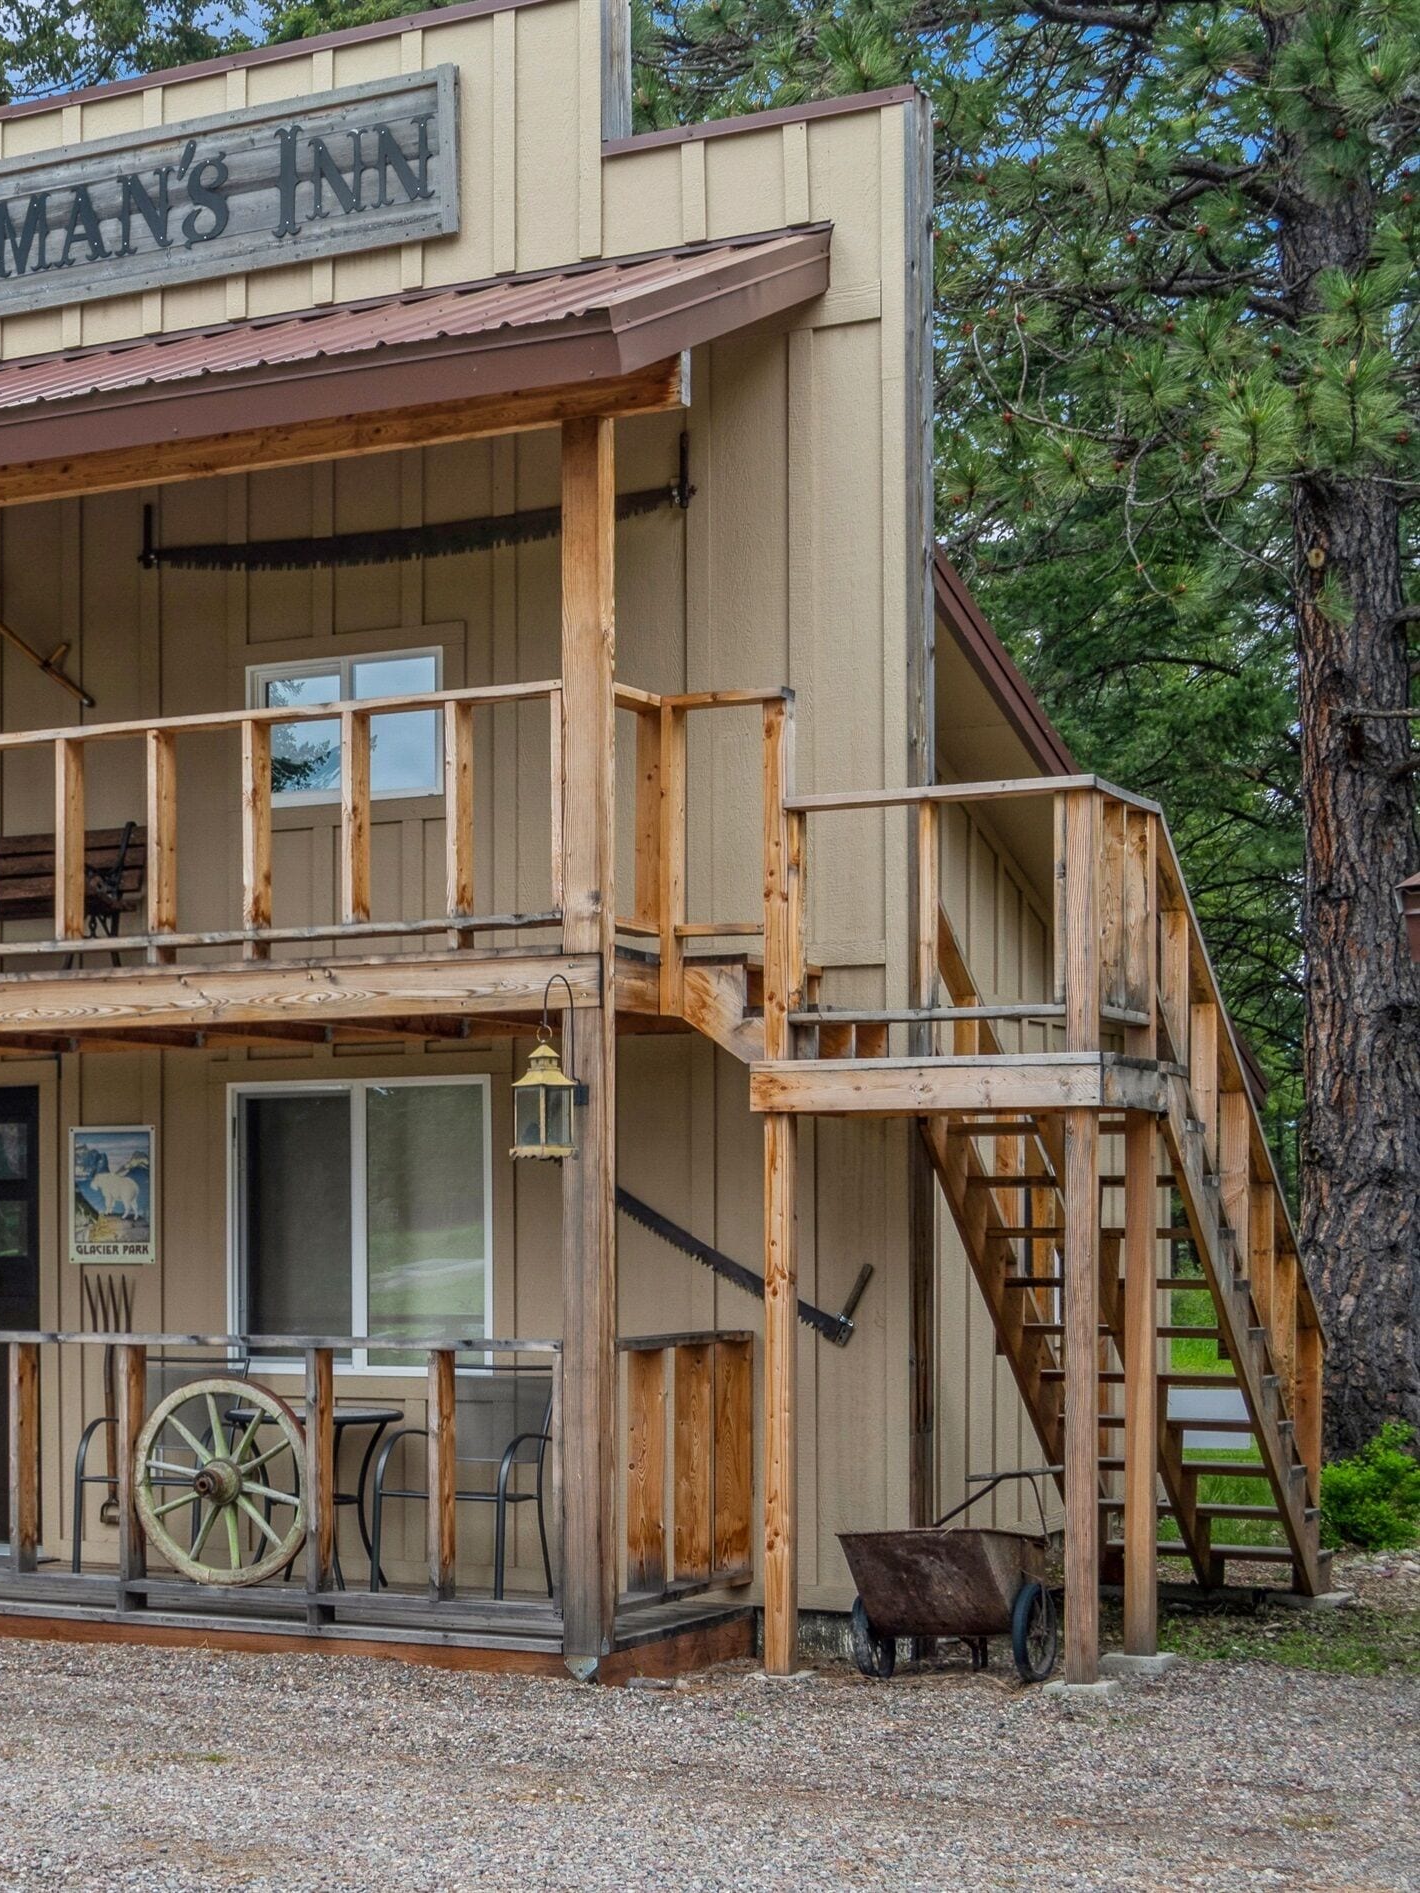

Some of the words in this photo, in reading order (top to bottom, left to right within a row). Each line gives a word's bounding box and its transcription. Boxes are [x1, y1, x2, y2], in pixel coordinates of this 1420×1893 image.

[271, 114, 437, 238] INN
[76, 1244, 119, 1255] GLACIER
[123, 1244, 149, 1255] PARK
